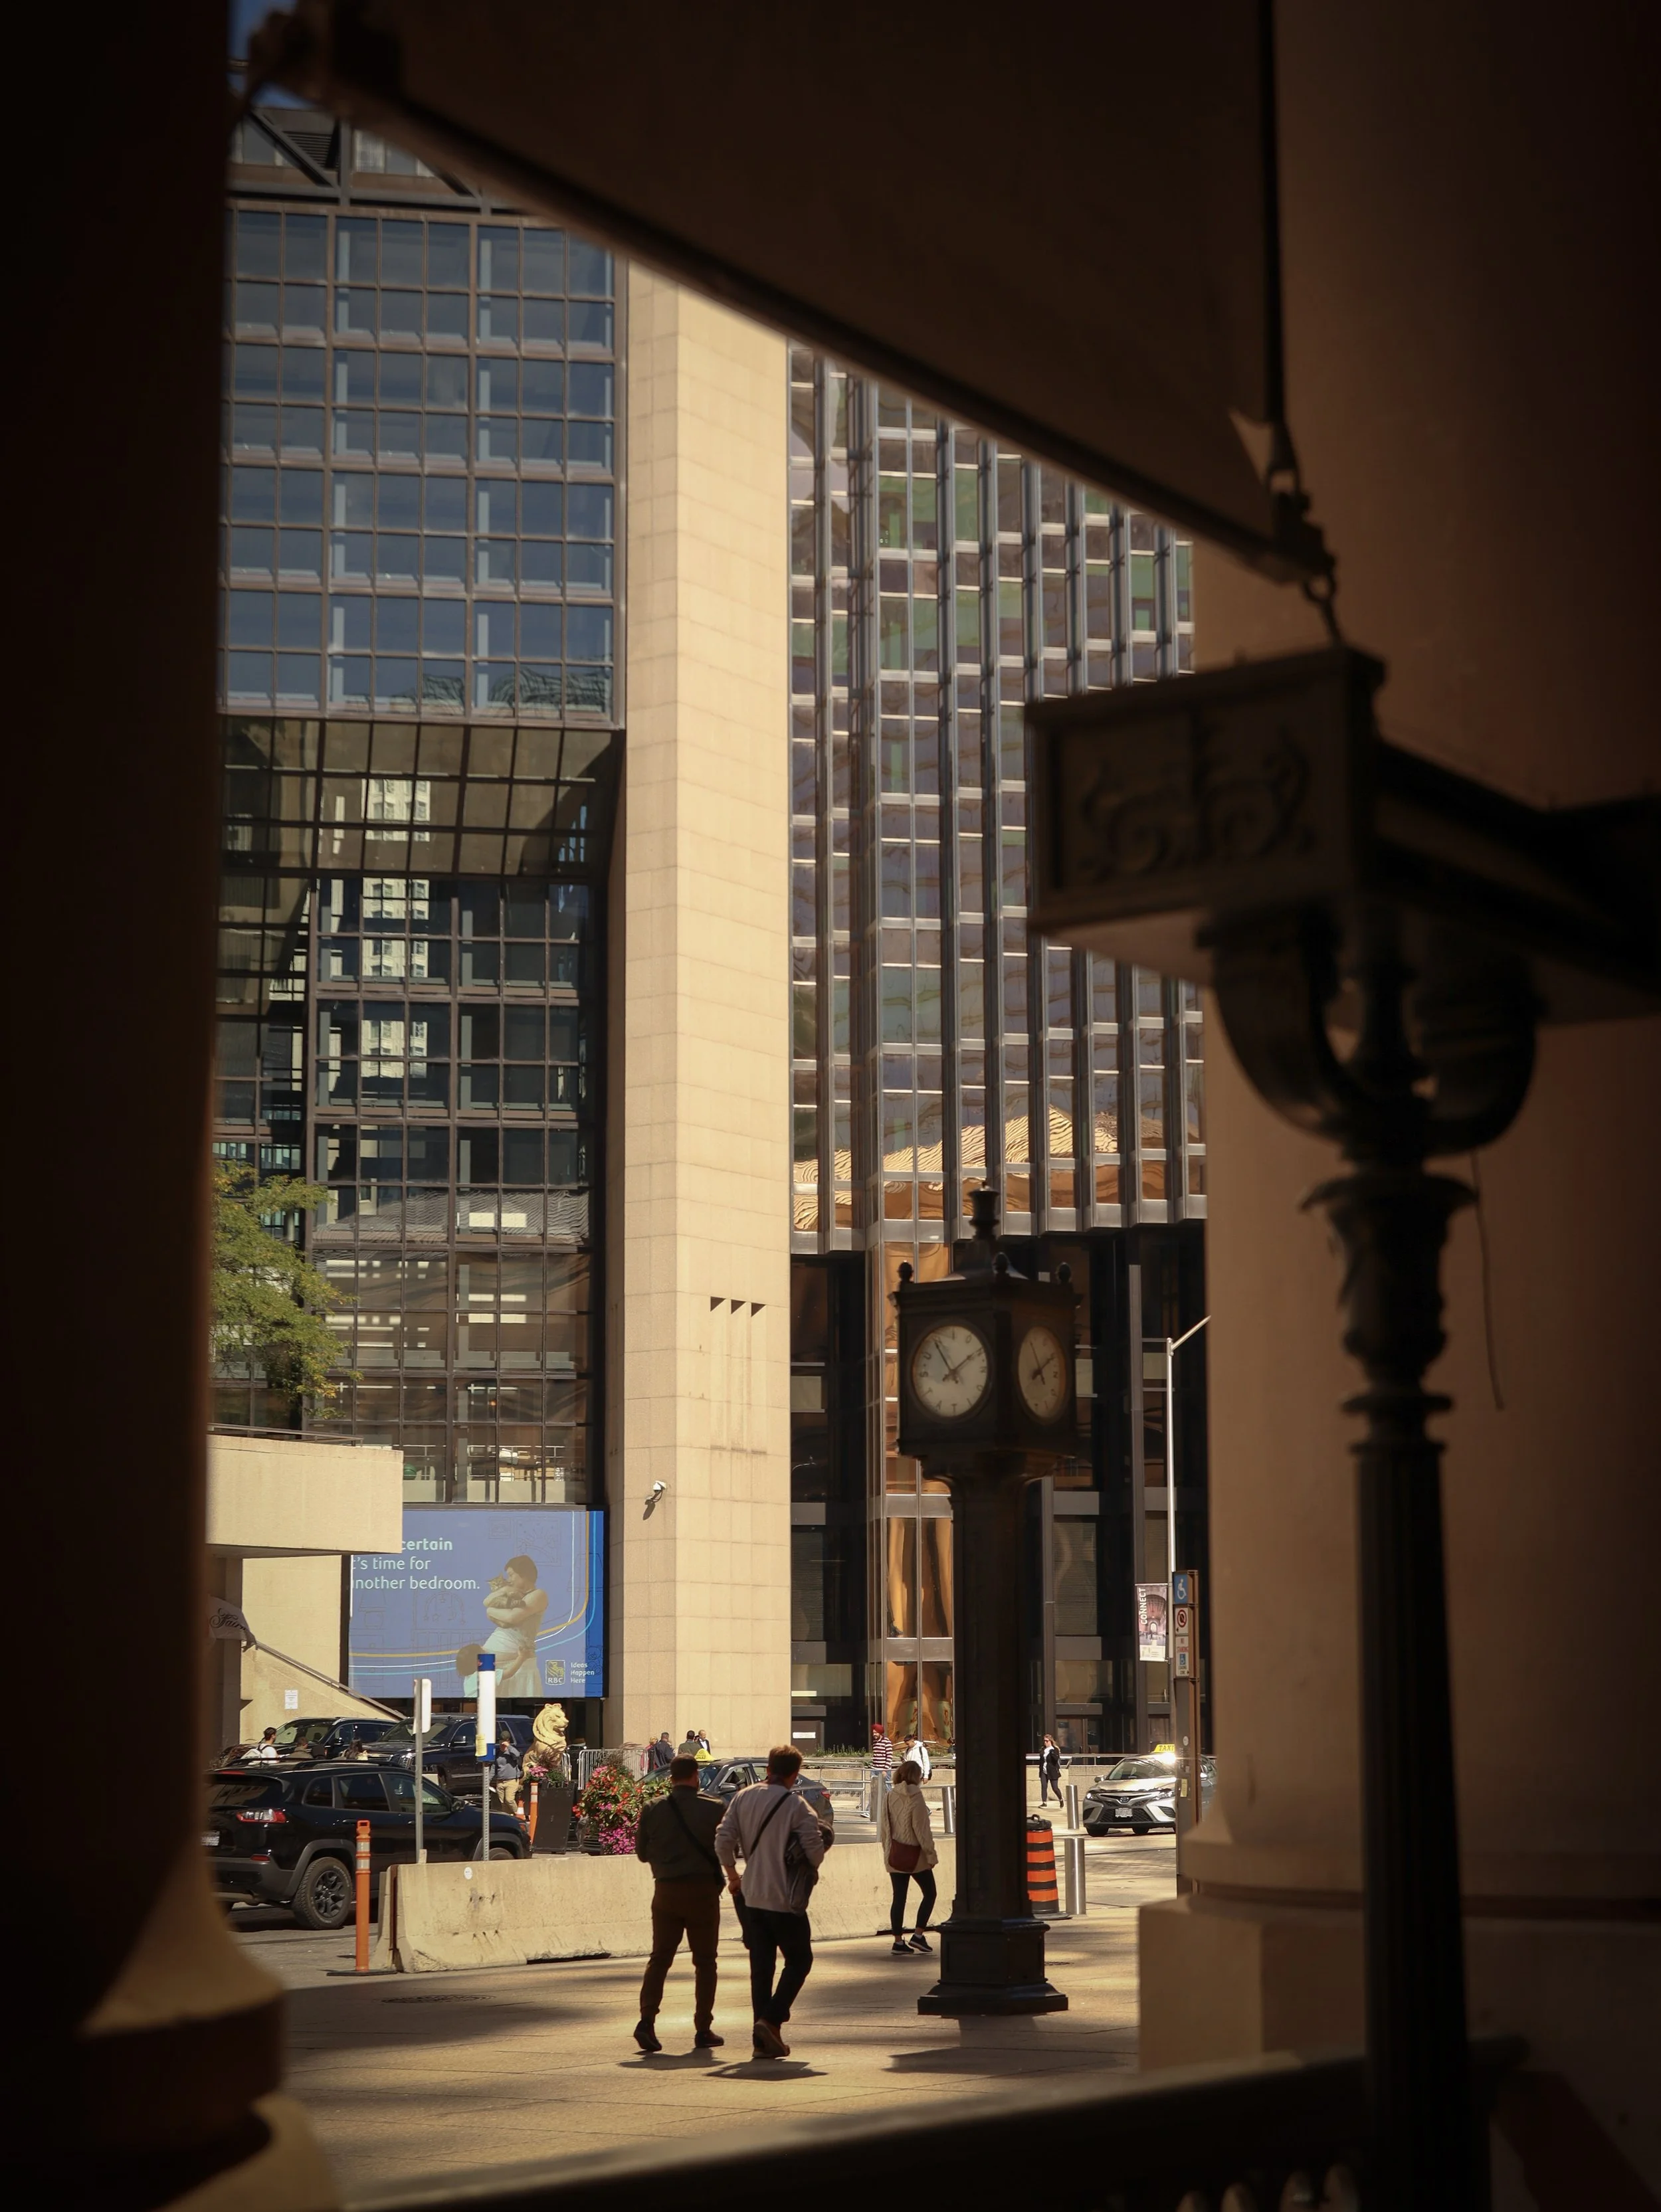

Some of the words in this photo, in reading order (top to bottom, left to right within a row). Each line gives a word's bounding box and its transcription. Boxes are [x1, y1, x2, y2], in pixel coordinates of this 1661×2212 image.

[373, 1556, 405, 1570] time
[409, 1556, 431, 1570] for
[353, 1575, 406, 1590] nother
[409, 1575, 480, 1590] bedroom.
[1138, 1588, 1148, 1625] CONNECT
